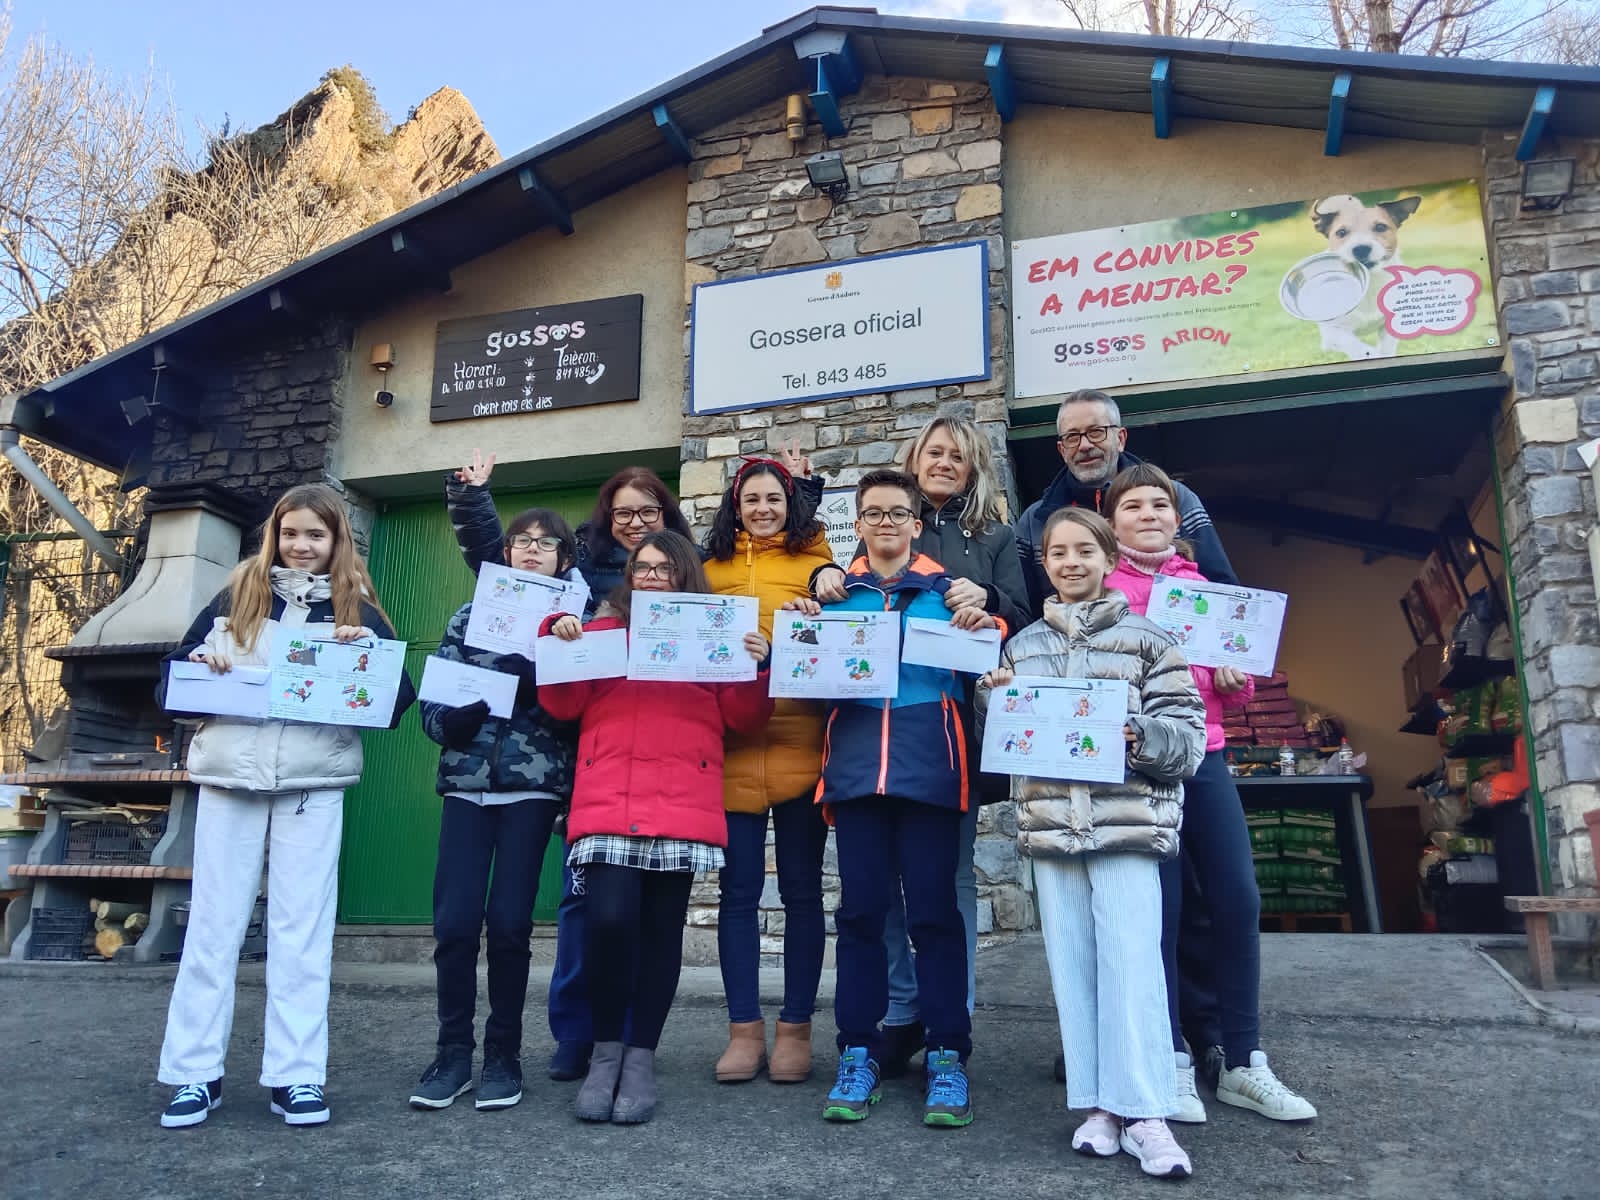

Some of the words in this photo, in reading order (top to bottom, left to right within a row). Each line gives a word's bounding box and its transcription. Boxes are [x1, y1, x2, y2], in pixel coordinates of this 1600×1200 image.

[1027, 256, 1079, 283] EM
[1094, 231, 1259, 273] CONVIDES
[1039, 293, 1064, 317] A
[1077, 264, 1248, 312] MENJAR?
[750, 321, 846, 350] Gossera
[854, 306, 922, 336] oficial
[1161, 327, 1231, 353] ARION
[782, 374, 811, 390] Tel.
[816, 368, 849, 385] 843
[854, 362, 887, 380] 485
[826, 534, 859, 543] videov
[829, 521, 855, 532] insta
